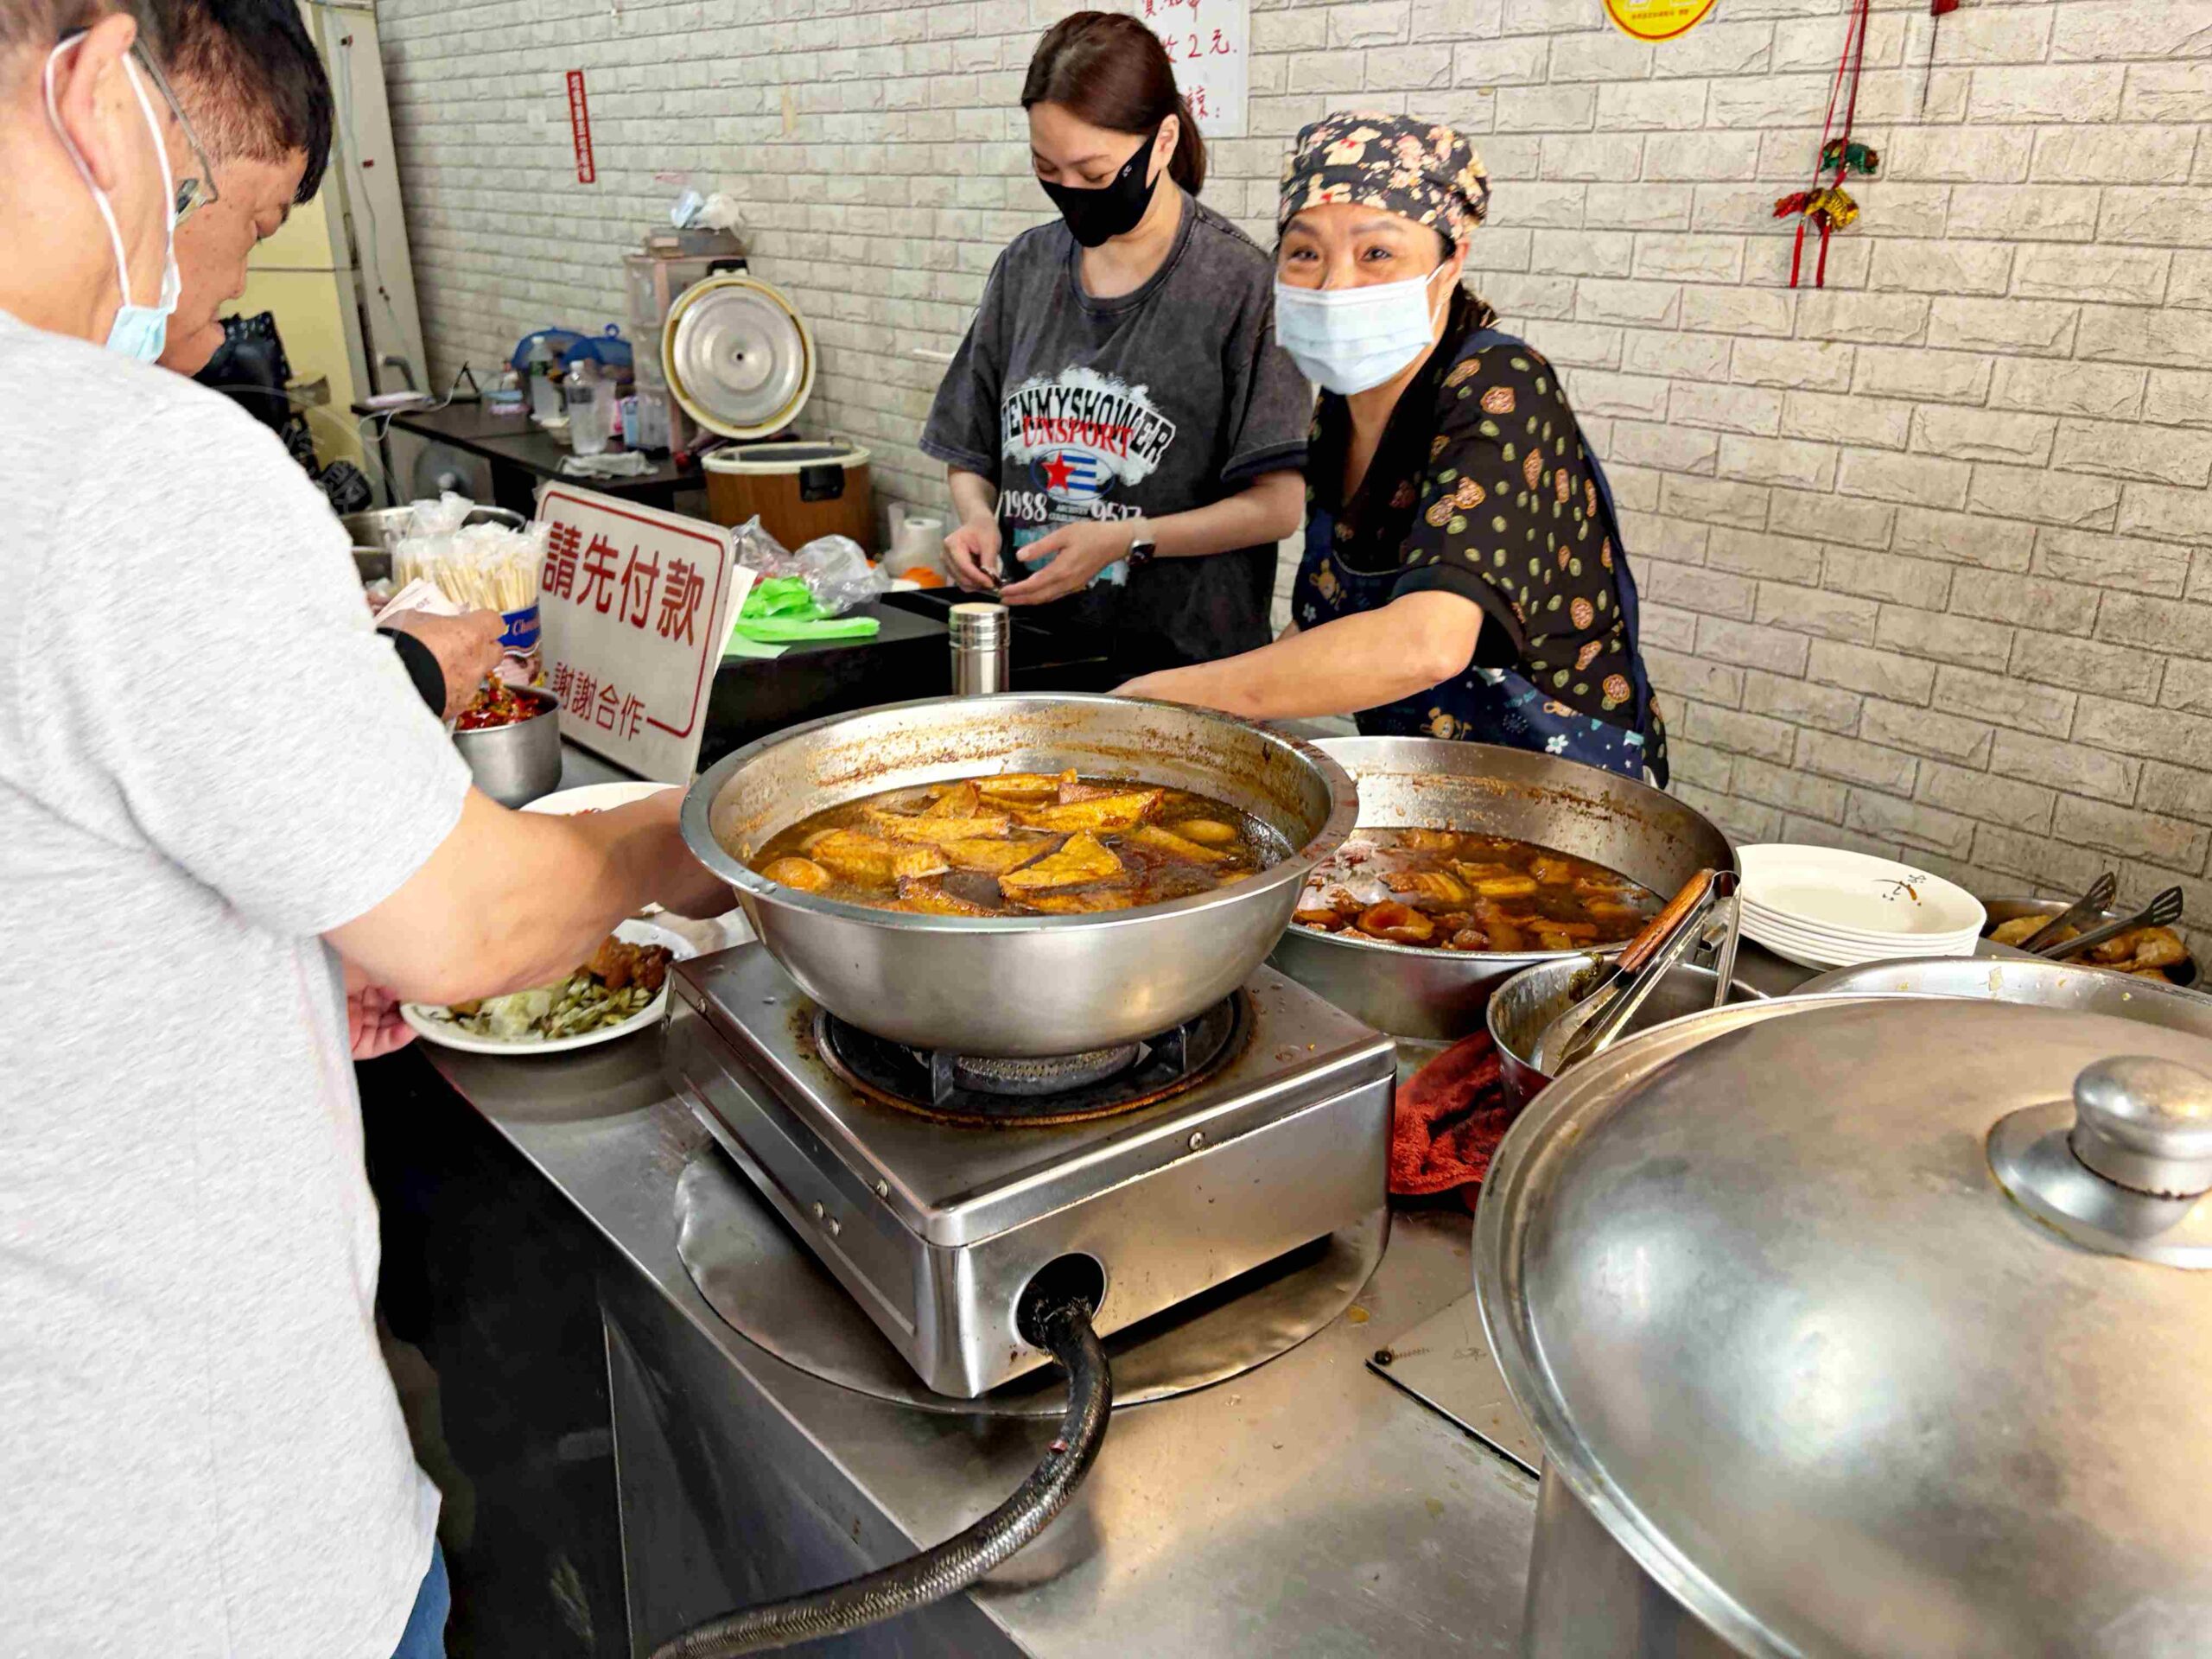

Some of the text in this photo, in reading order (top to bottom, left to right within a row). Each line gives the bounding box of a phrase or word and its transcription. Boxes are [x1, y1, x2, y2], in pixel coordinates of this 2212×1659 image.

[1022, 415, 1134, 461] UNSPORT
[1004, 489, 1048, 522] 1988
[541, 520, 705, 646] 請先付款
[550, 661, 645, 741] 謝謝合作
